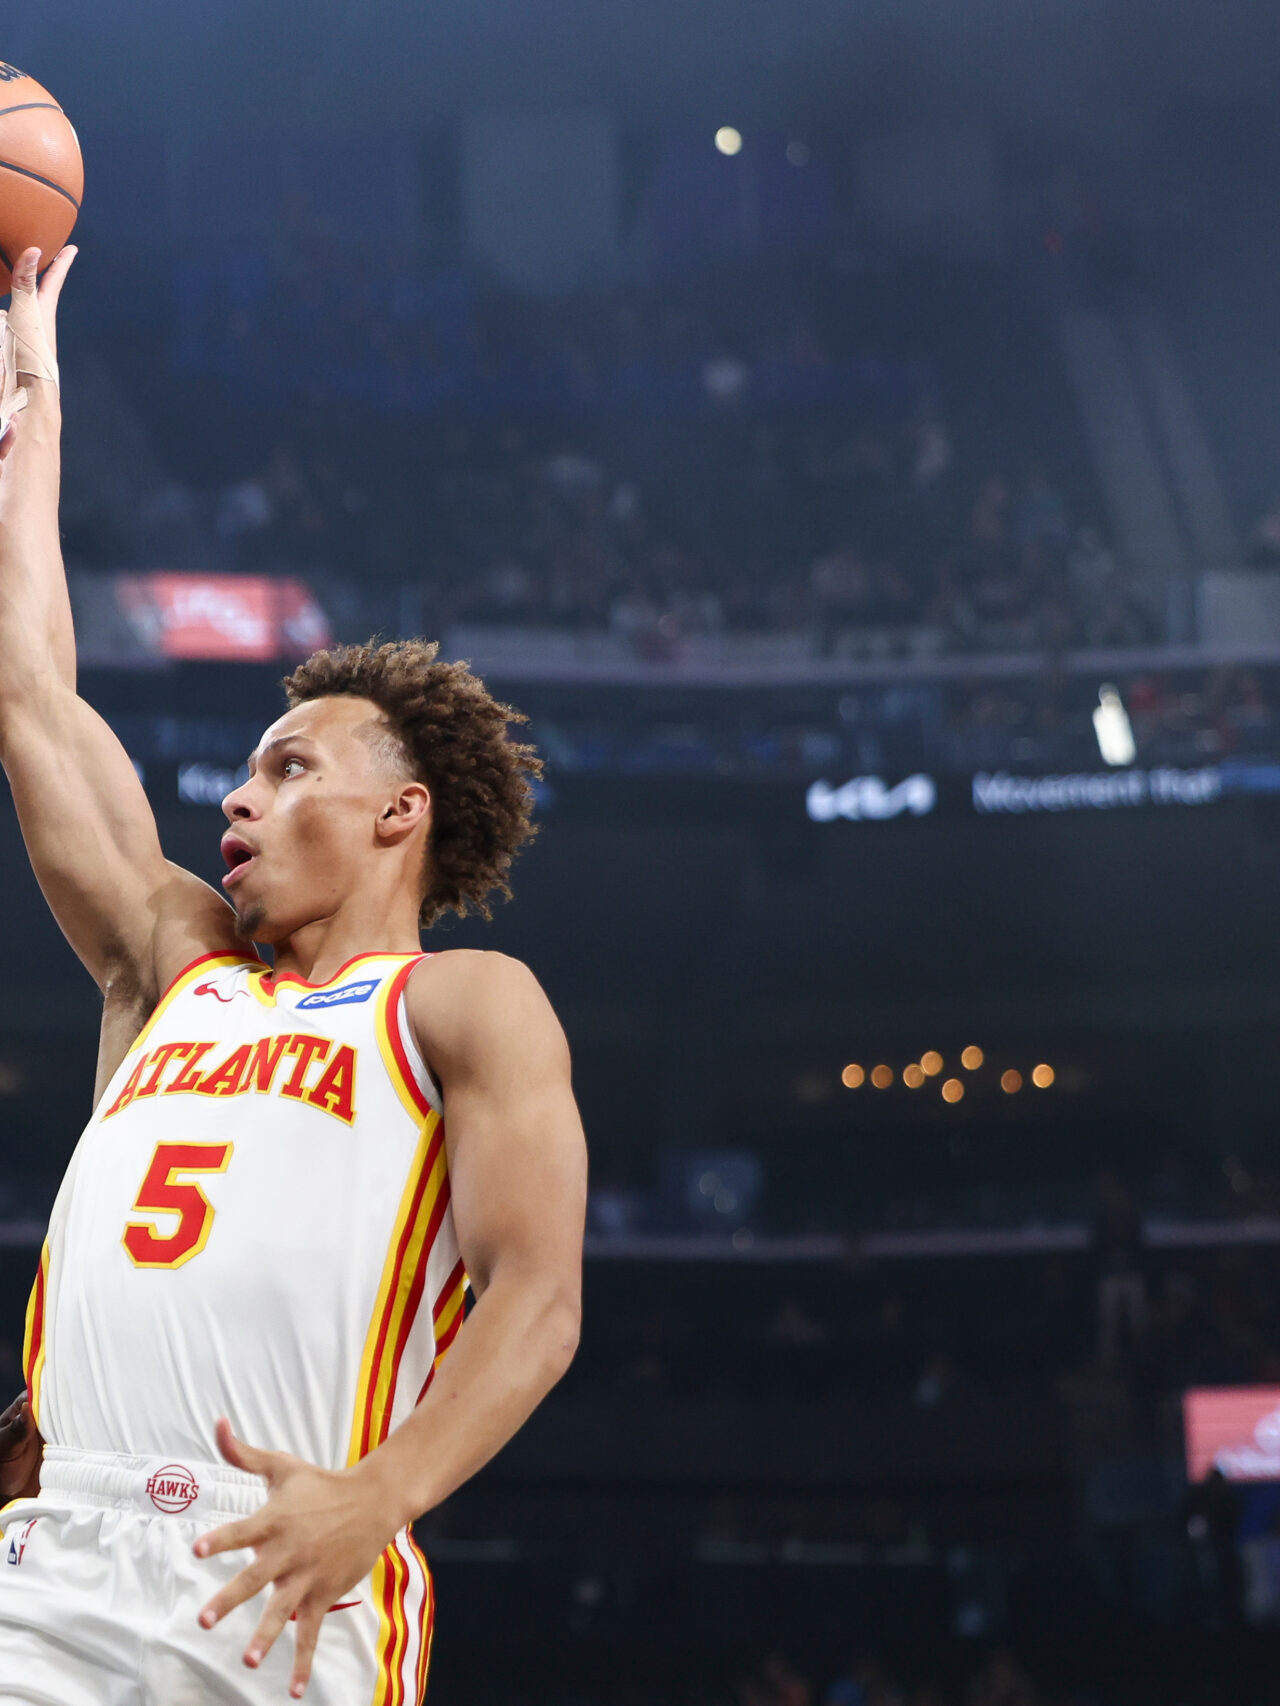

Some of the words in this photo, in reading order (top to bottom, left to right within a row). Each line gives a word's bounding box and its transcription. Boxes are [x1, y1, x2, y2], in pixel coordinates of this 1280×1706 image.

[99, 1032, 358, 1128] ATLANTA
[121, 1140, 235, 1271] 5
[145, 1477, 200, 1501] HAWKS
